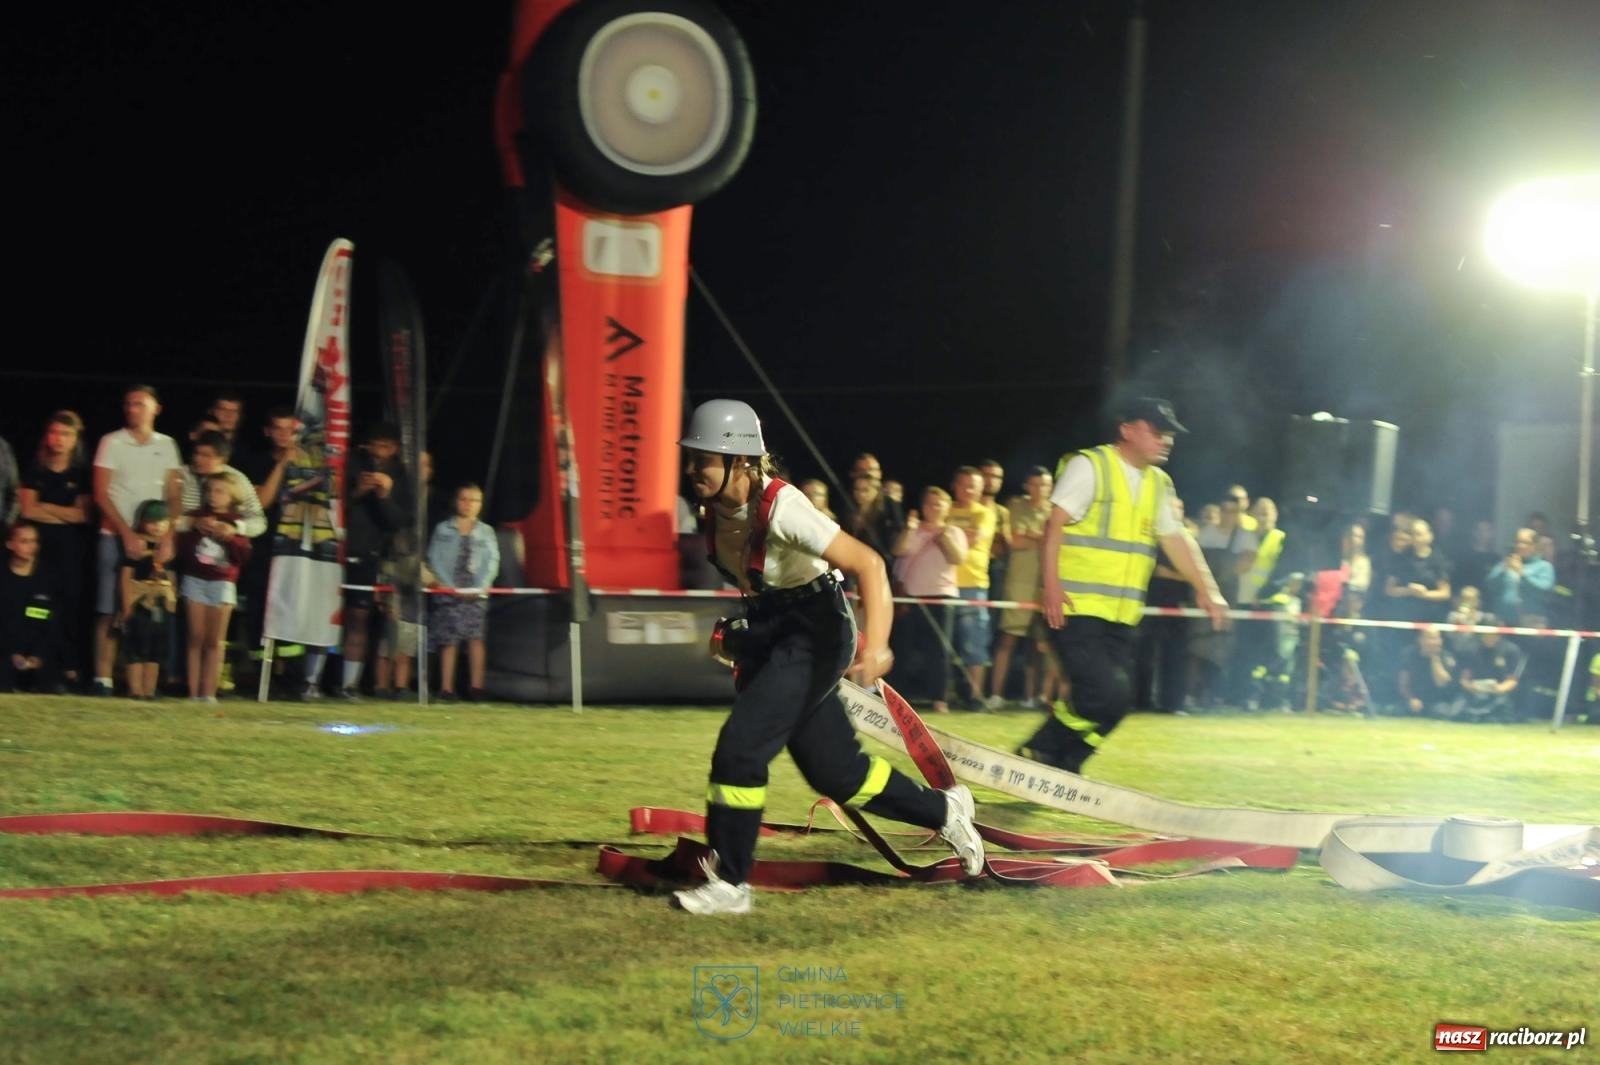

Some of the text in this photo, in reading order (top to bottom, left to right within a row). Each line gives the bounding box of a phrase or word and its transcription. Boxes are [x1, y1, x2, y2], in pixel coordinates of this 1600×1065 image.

[618, 376, 645, 518] Mactronic
[864, 709, 889, 729] 2023
[1008, 769, 1025, 785] TYP
